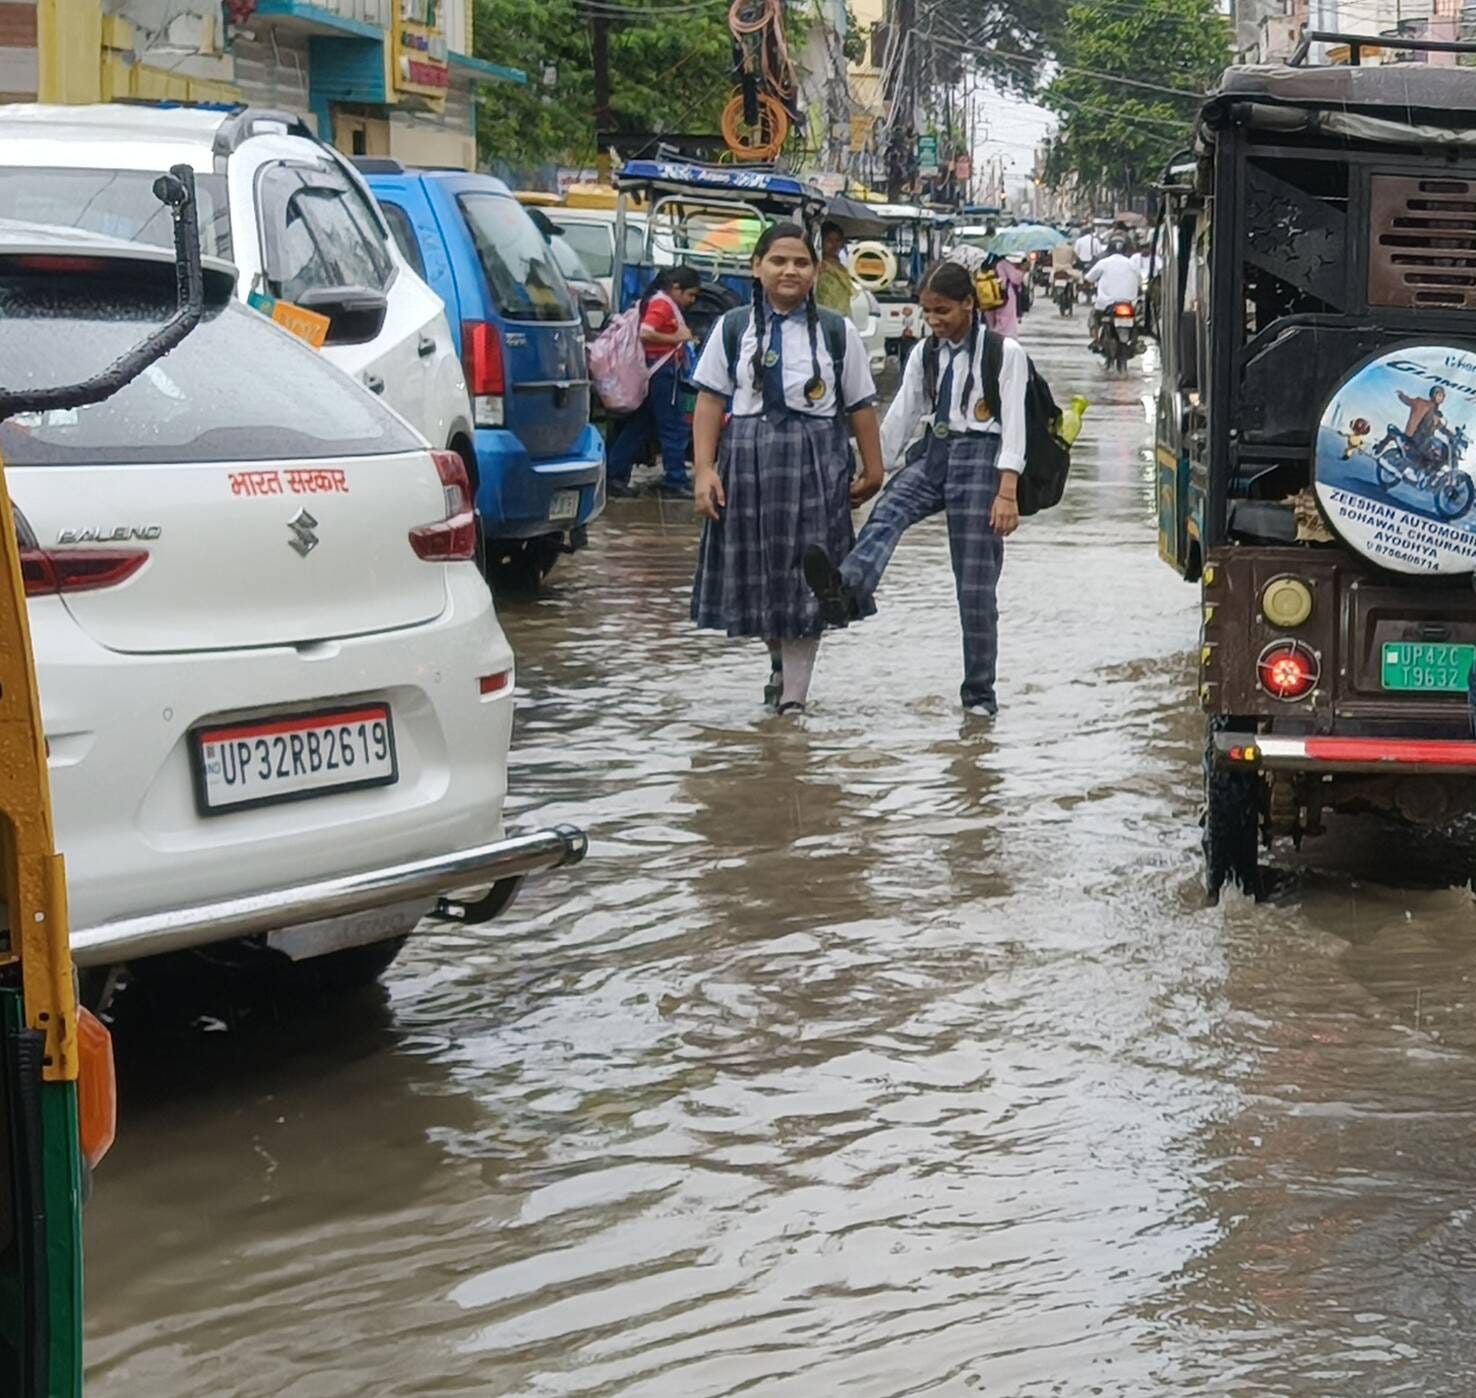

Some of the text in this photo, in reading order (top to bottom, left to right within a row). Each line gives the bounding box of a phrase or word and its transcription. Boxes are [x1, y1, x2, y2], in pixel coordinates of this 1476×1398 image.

[228, 469, 349, 496] भारत सरकार
[1330, 490, 1395, 520] ZEESHAN
[57, 527, 162, 545] BALENO
[1374, 531, 1438, 558] AYODHYA
[220, 722, 388, 785] UP32RB2619
